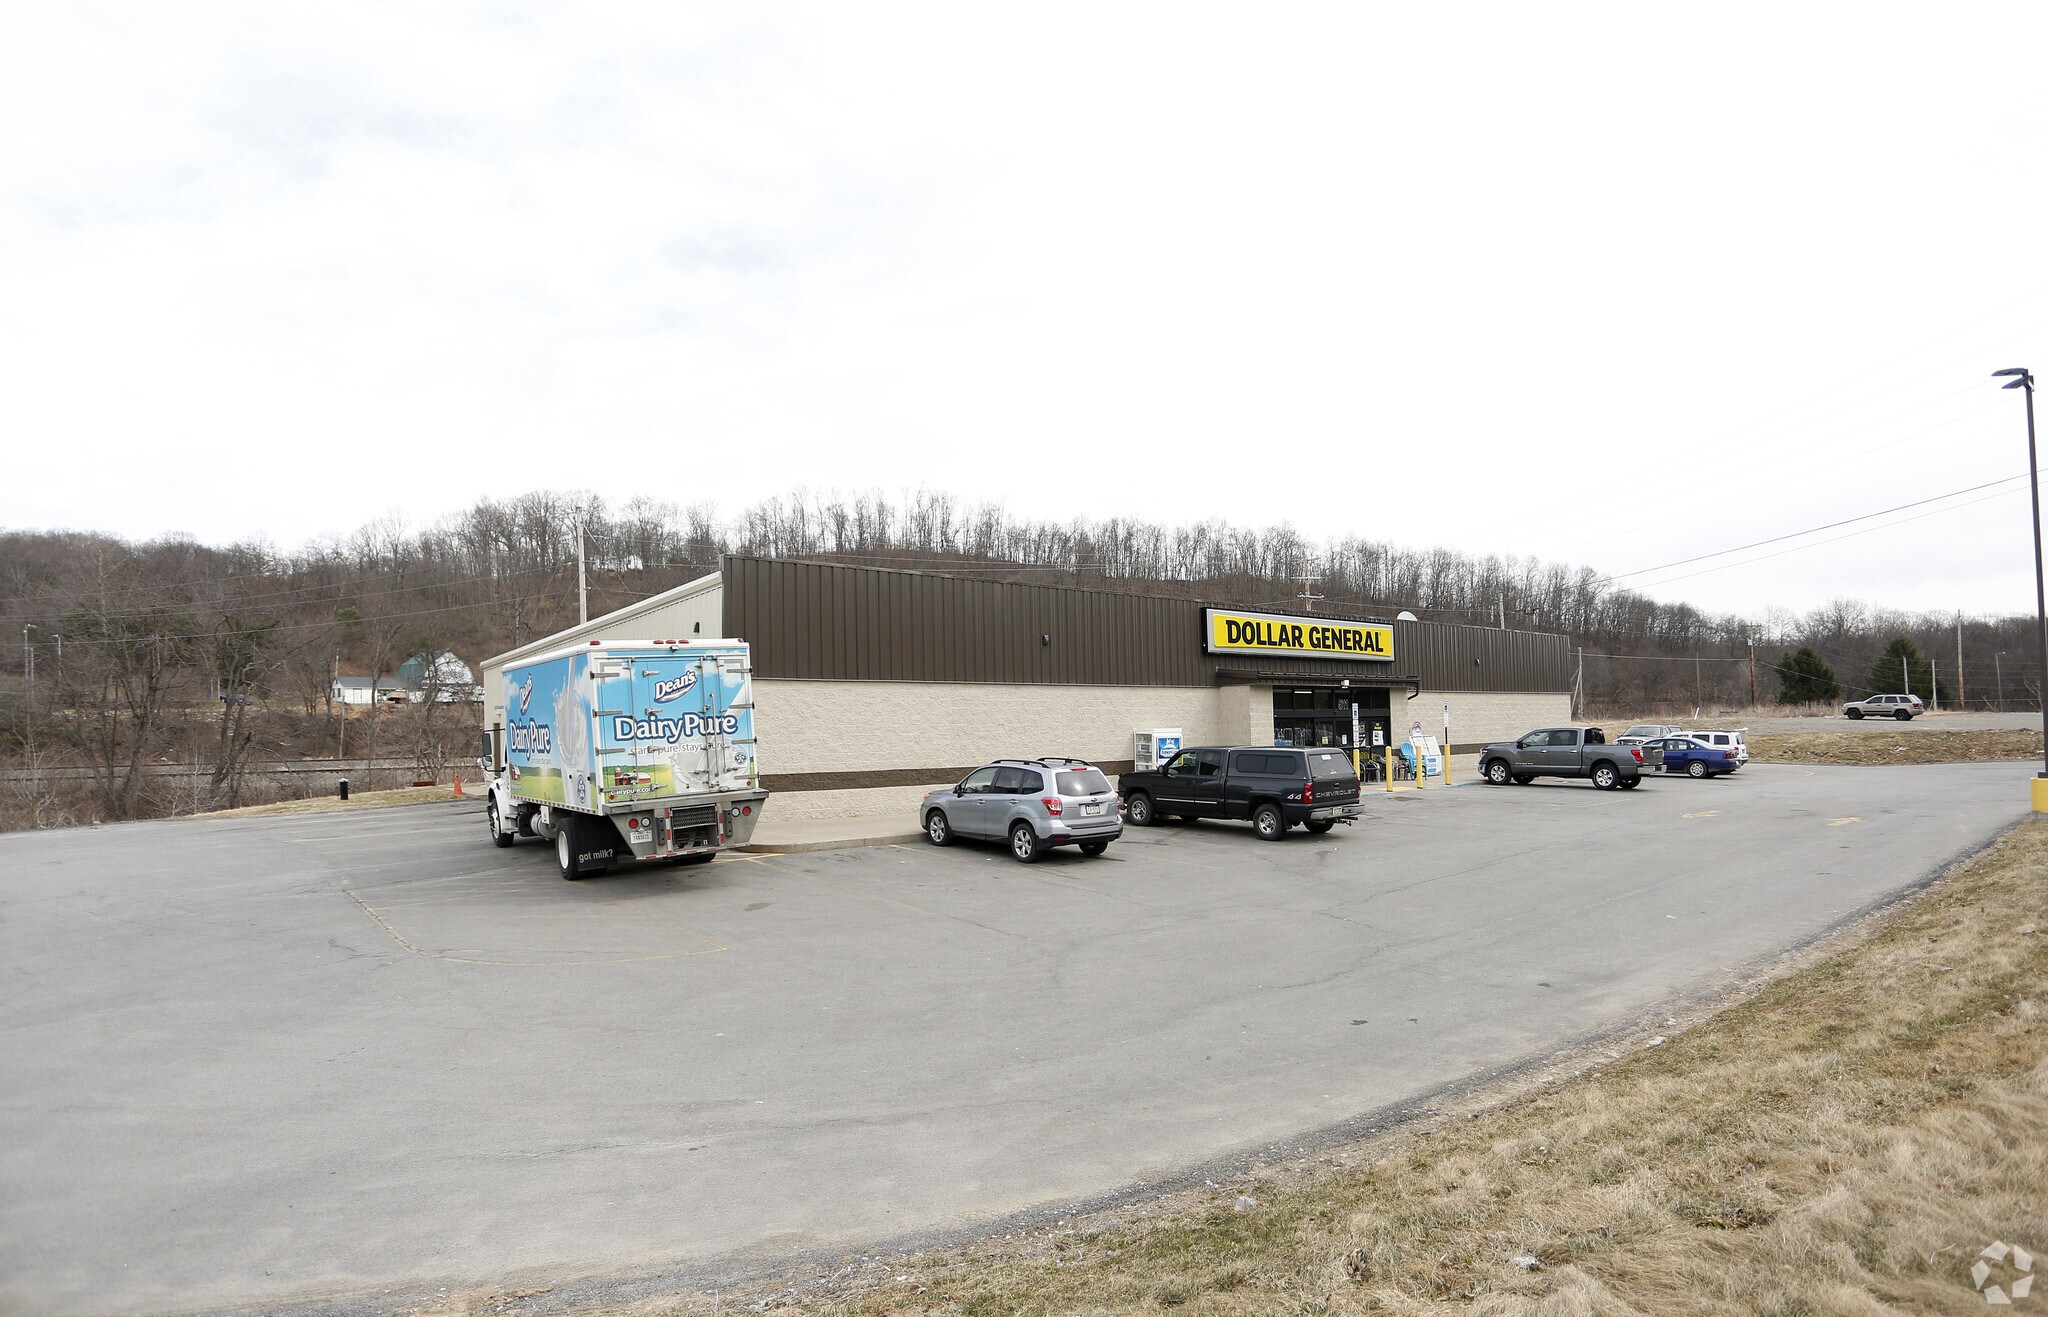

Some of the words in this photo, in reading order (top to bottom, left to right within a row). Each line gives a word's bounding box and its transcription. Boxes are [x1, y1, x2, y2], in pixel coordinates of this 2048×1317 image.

[1226, 620, 1304, 648] DOLLAR
[1309, 626, 1384, 652] GENERAL
[655, 670, 696, 700] Dean's
[509, 719, 551, 760] DairyPure
[614, 712, 738, 744] DairyPure
[1316, 788, 1356, 798] CHEVROLET
[579, 852, 591, 863] got
[593, 849, 613, 859] milk?
